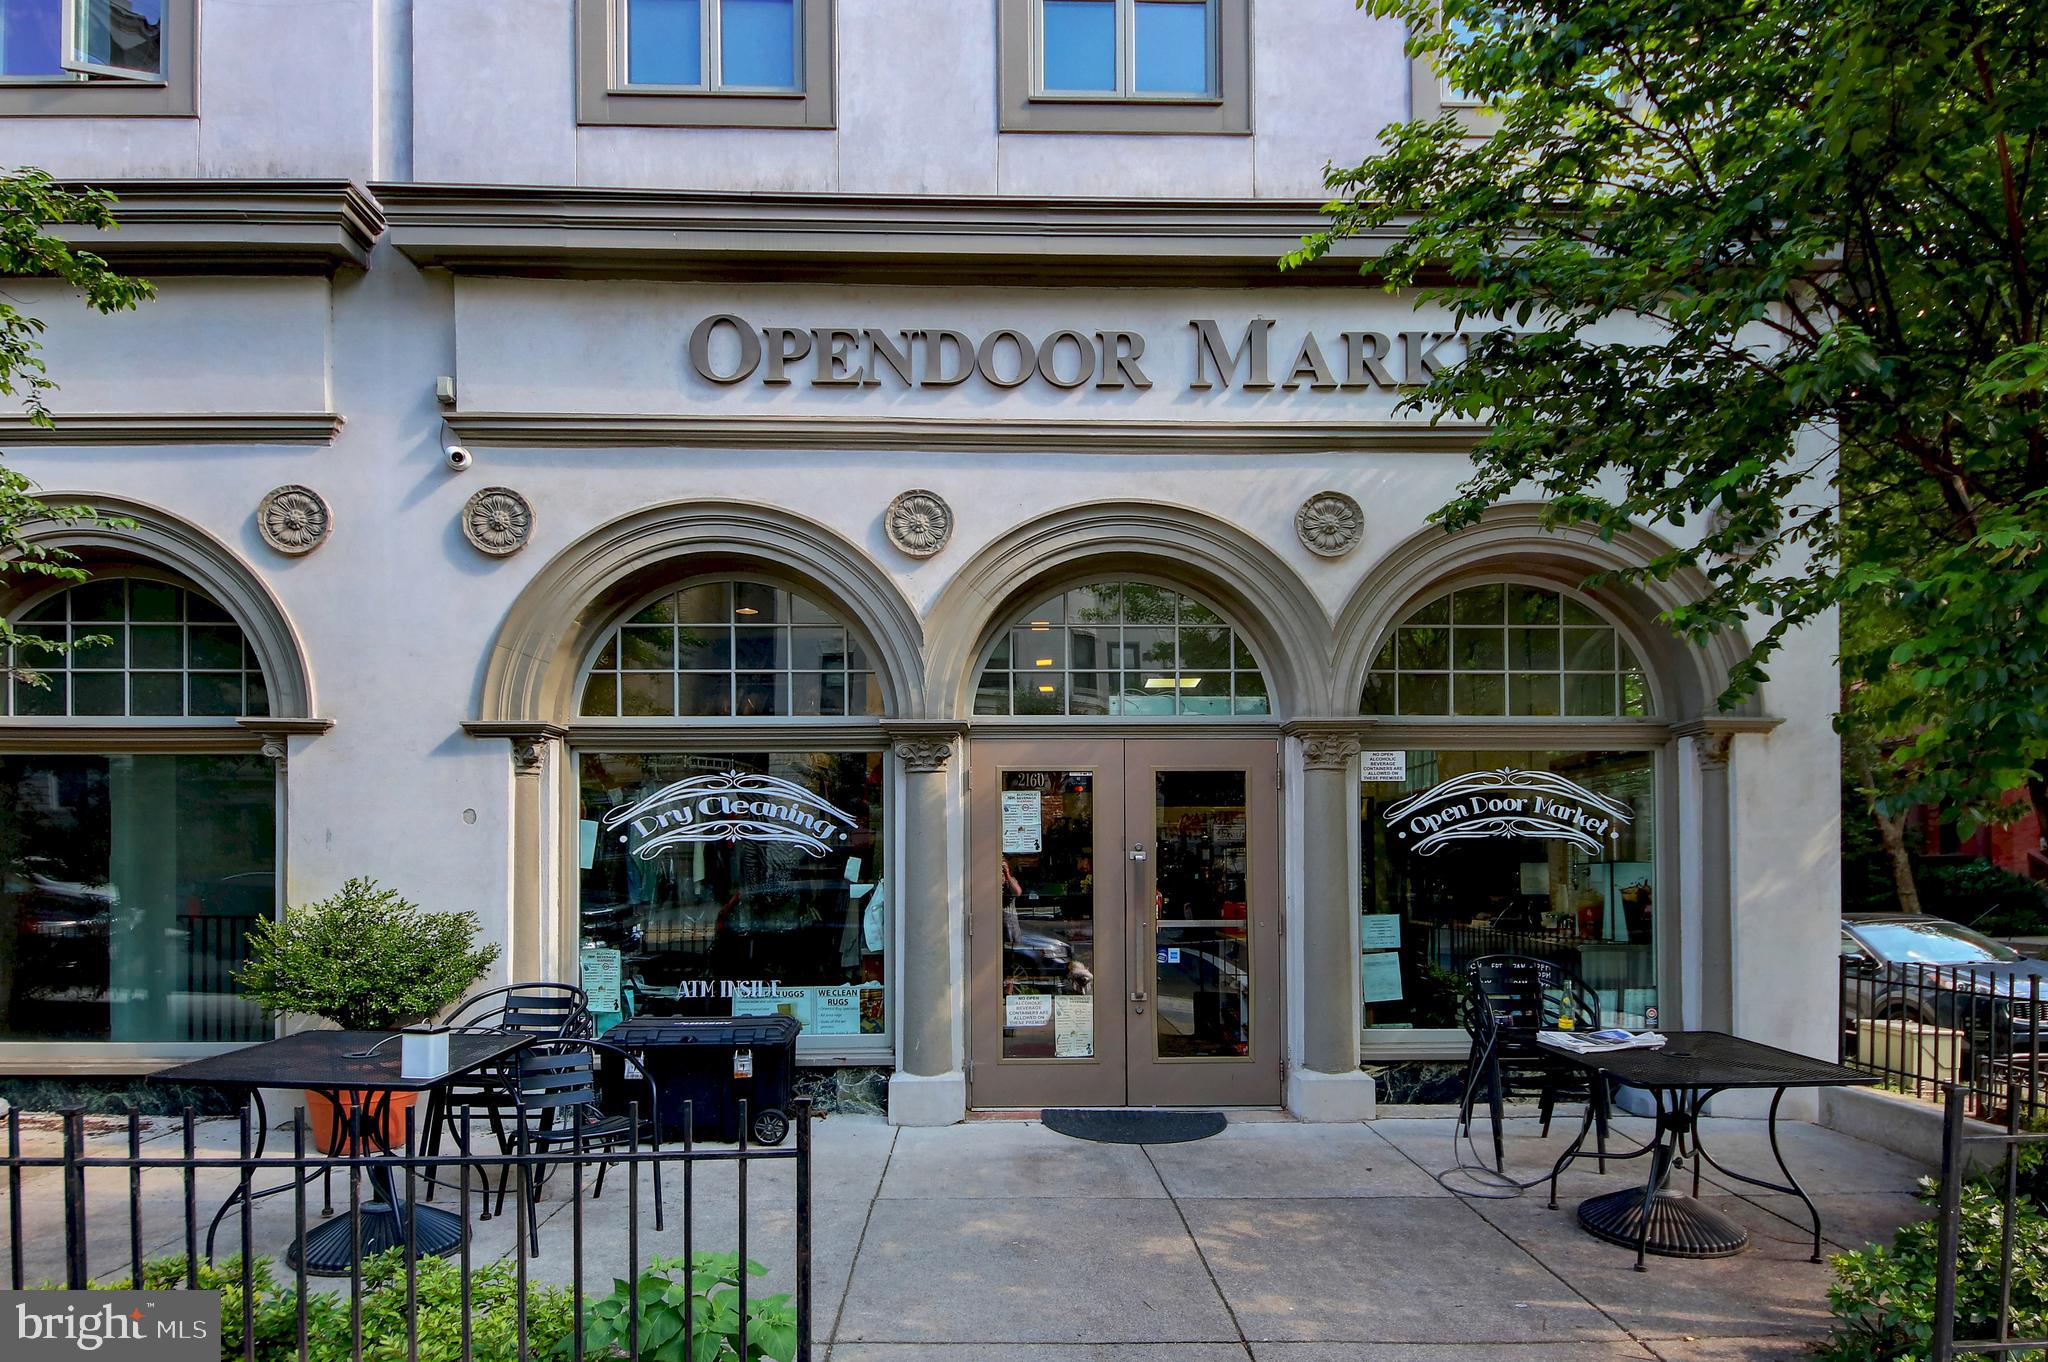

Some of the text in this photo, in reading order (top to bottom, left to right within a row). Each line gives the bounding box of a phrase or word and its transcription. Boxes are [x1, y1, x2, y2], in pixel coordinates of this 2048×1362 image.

[688, 313, 1152, 389] OPENDOOR
[1018, 772, 1045, 787] 2160
[630, 796, 838, 839] Dry Cleaning
[1410, 796, 1609, 836] Open Door Market
[678, 980, 715, 998] ATM
[720, 980, 782, 998] INSIDE
[782, 990, 805, 998] UGGS
[827, 998, 849, 1006] RUGS
